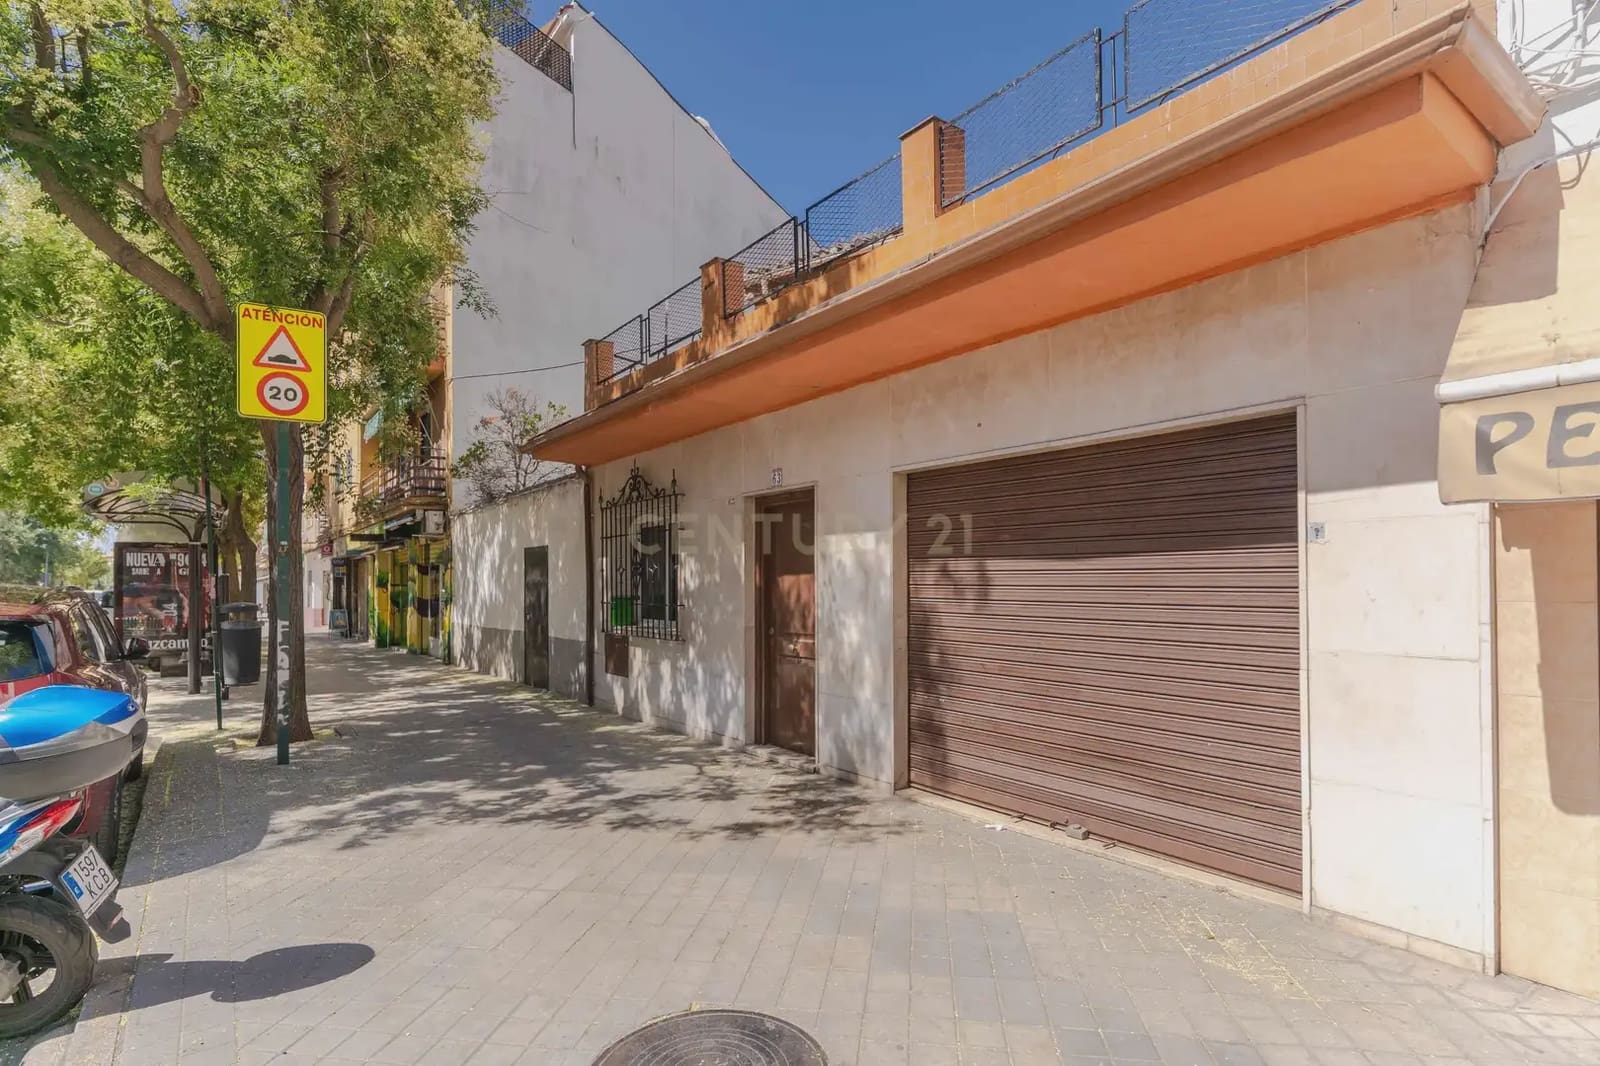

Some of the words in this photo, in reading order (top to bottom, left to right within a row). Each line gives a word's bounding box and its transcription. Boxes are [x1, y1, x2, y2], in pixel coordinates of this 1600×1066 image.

[268, 386, 298, 401] 20
[74, 849, 98, 883] 1597
[85, 867, 110, 900] KCB
